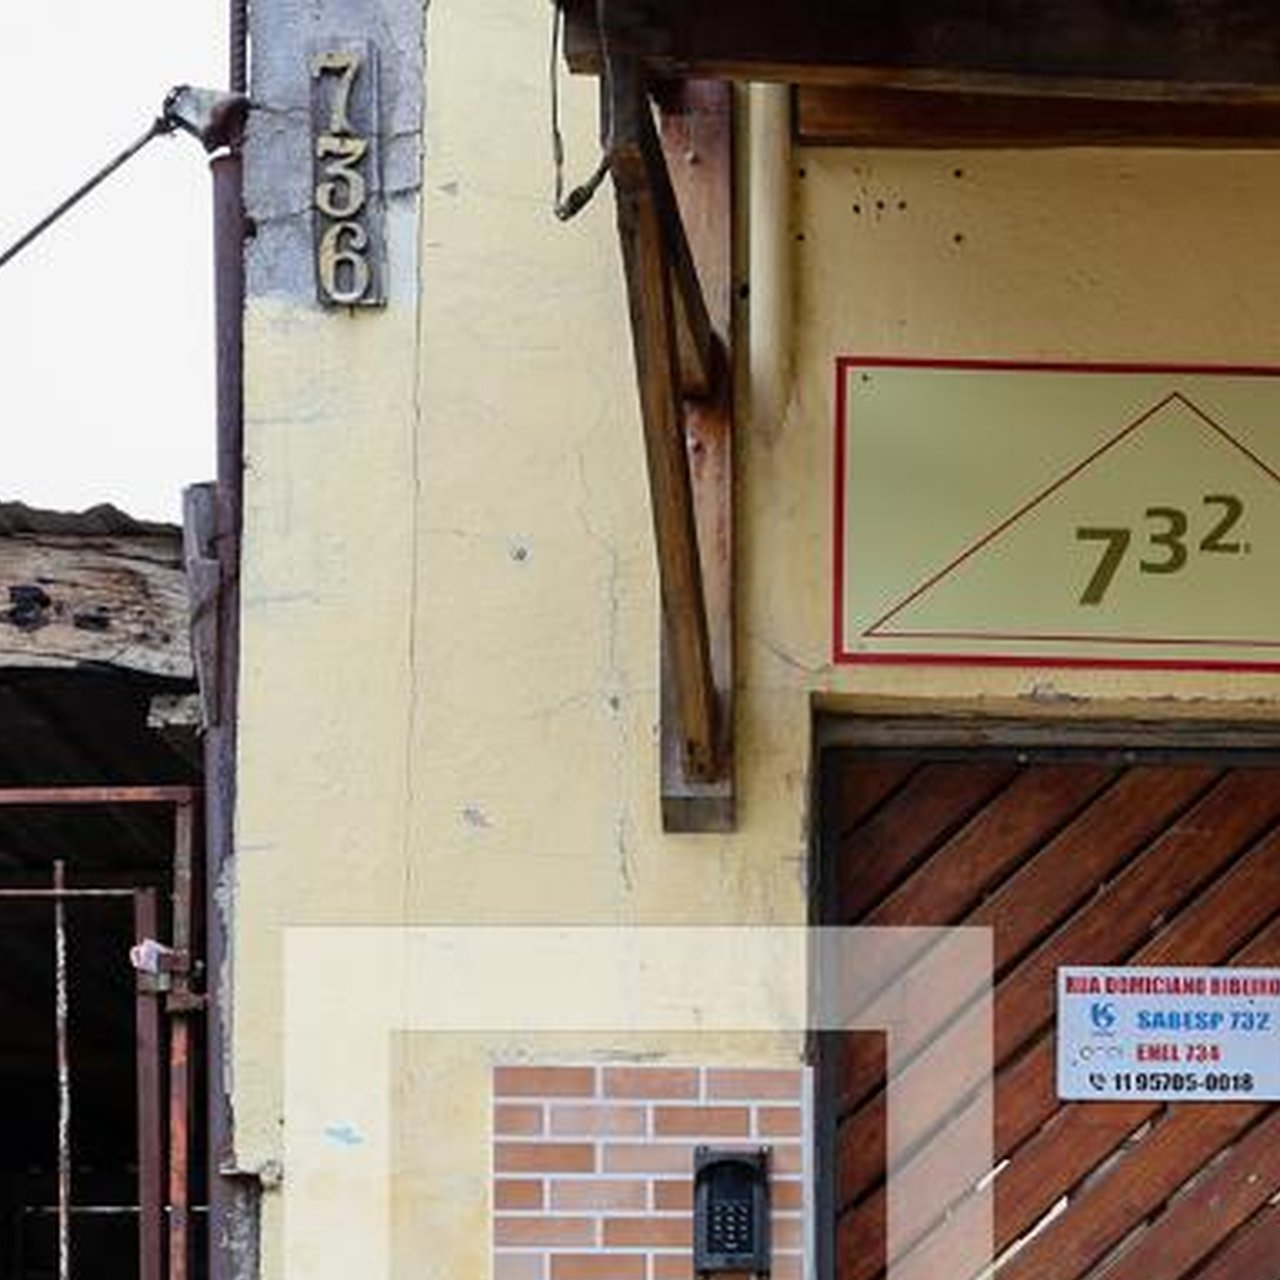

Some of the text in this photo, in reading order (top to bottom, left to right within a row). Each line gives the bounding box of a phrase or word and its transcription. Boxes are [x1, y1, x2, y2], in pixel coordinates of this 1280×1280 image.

[308, 52, 371, 303] 736
[1076, 494, 1245, 606] 732
[1066, 976, 1101, 994] RUA
[1105, 976, 1206, 995] DOMICIANO
[1136, 1010, 1272, 1031] SABESP 732
[1137, 1044, 1180, 1062] ENEL
